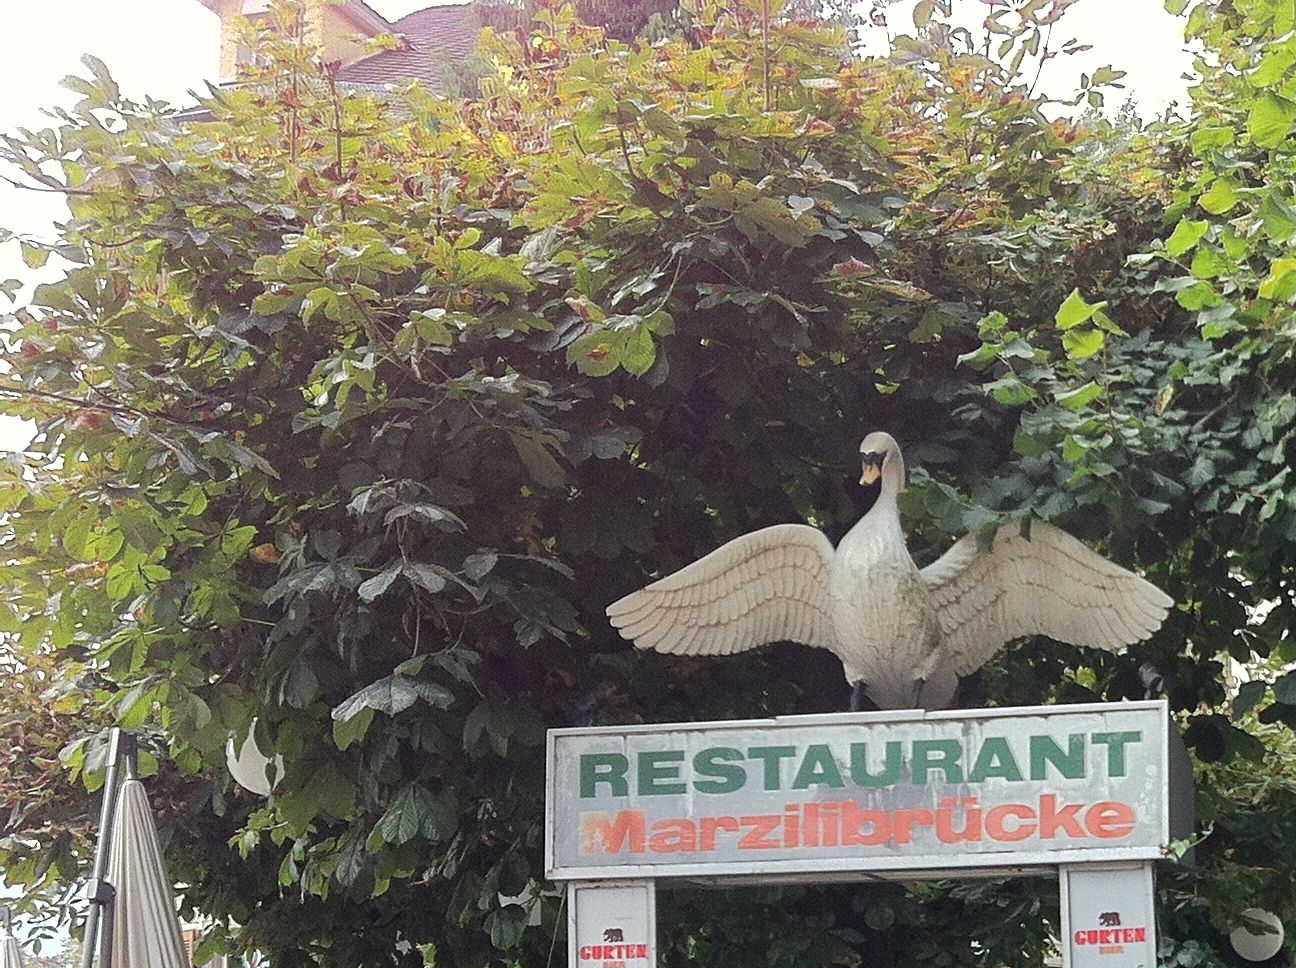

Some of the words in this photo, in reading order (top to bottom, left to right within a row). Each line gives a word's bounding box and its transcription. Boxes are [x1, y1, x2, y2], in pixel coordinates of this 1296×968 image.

[579, 730, 1142, 798] RESTAURANT
[579, 793, 1137, 855] Marzilibrücke
[579, 944, 648, 960] GURTEN
[1074, 928, 1145, 945] GURTEN
